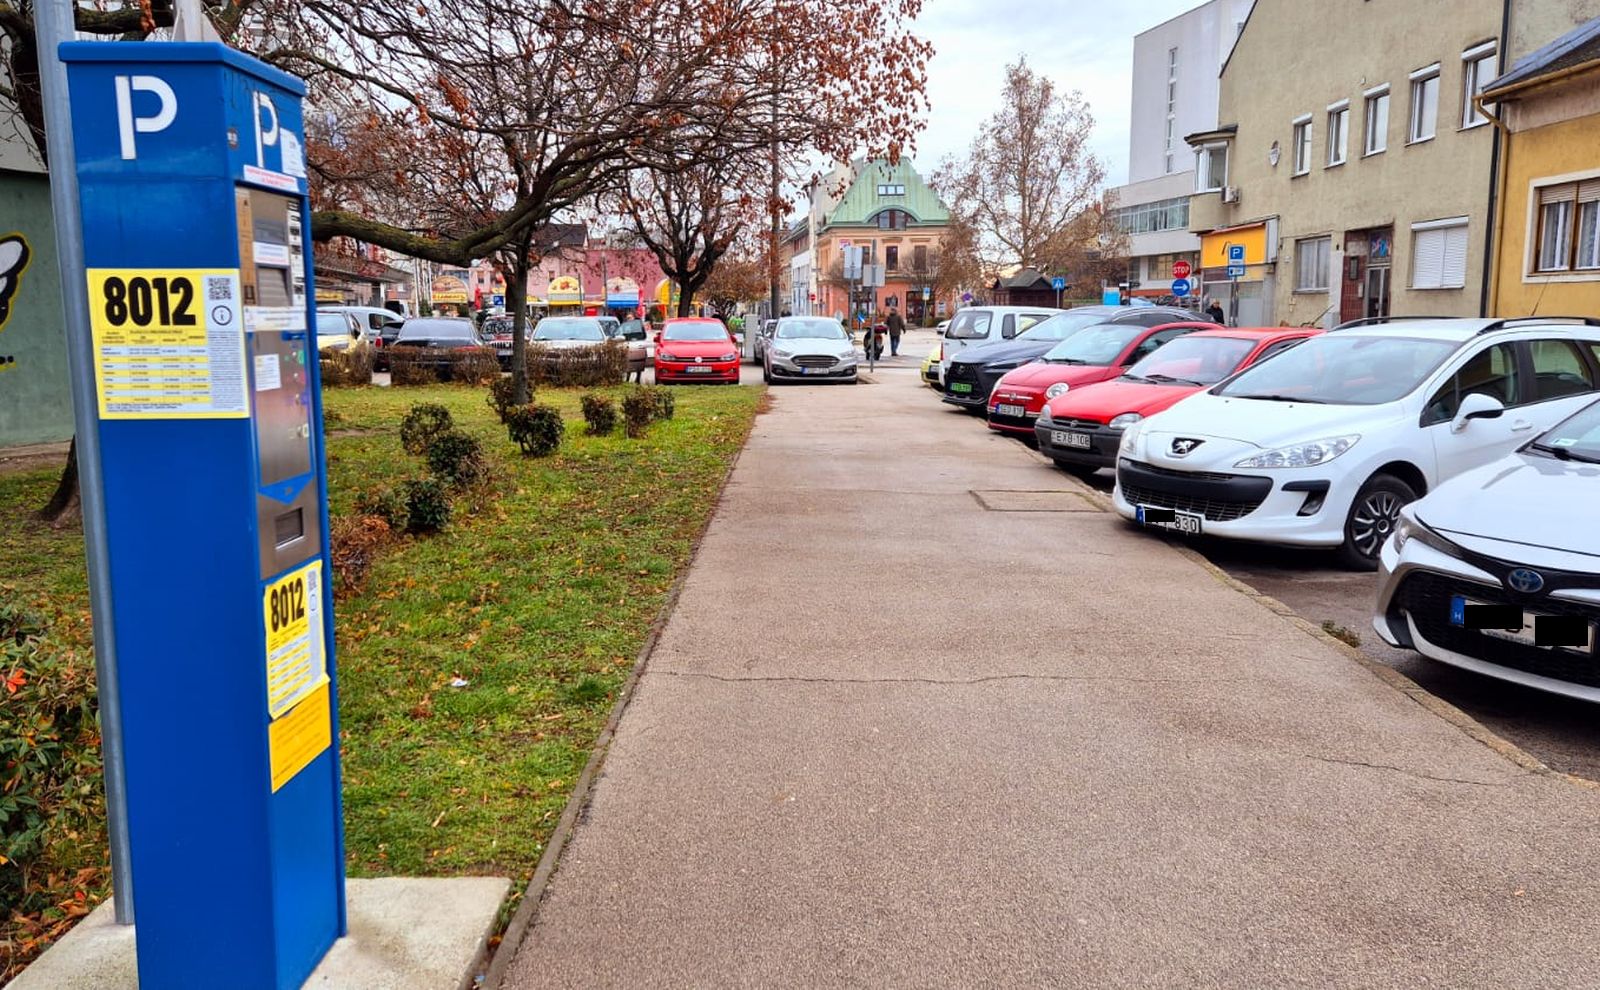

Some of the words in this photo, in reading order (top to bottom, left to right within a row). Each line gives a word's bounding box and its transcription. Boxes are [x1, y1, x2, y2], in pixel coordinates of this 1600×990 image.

[115, 75, 177, 160] P
[253, 91, 278, 168] P
[1173, 266, 1190, 275] STOP
[1232, 248, 1241, 258] P
[103, 276, 196, 327] 8012
[270, 577, 304, 632] 8012
